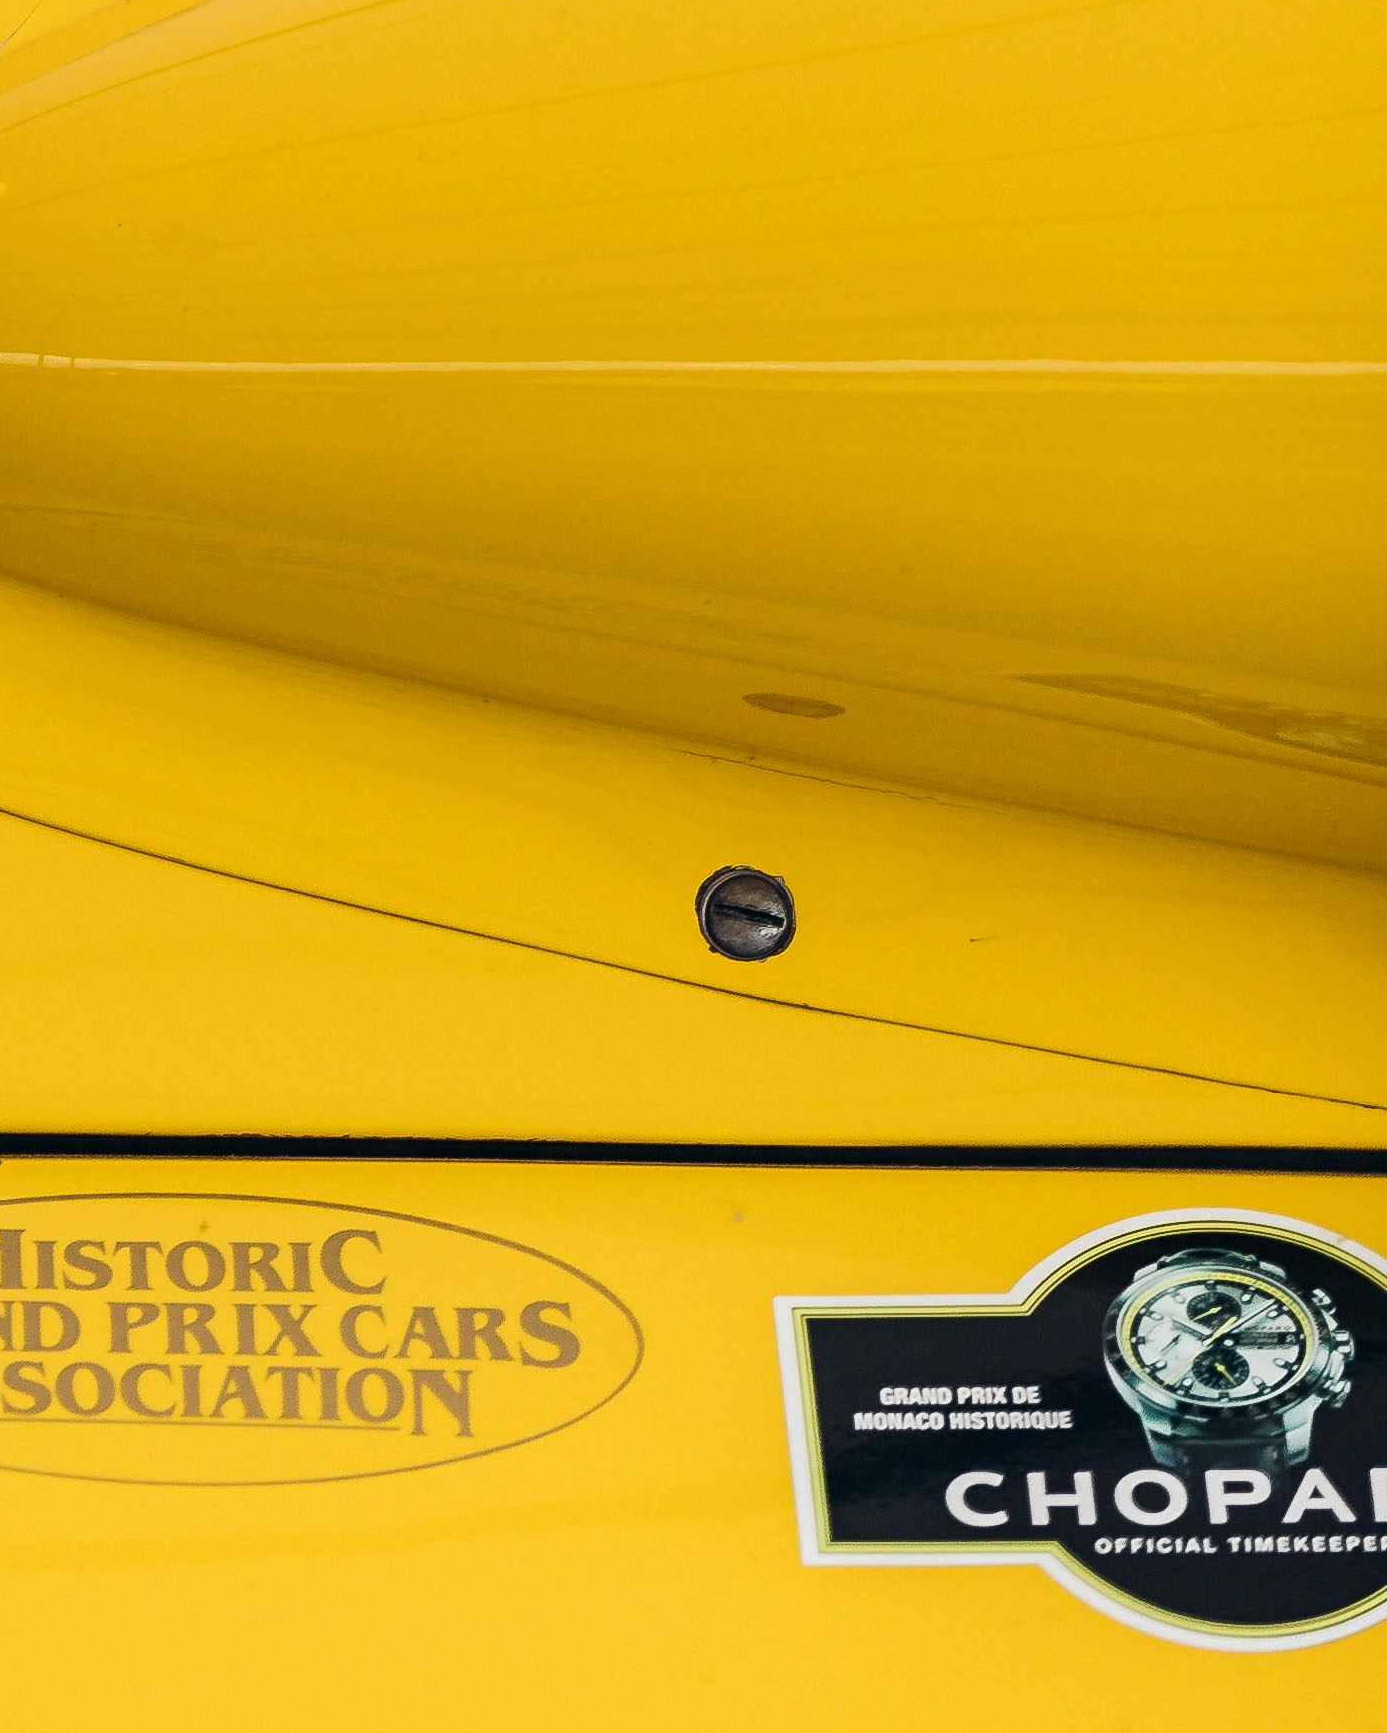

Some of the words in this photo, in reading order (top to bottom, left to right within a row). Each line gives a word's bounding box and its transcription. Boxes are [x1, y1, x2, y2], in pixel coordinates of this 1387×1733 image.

[107, 1299, 325, 1358] PRIX
[338, 1298, 582, 1370] CARS
[880, 1386, 952, 1406] GRAND
[957, 1386, 1009, 1406] PRIX
[1011, 1385, 1041, 1404] DE
[854, 1412, 944, 1431] MONACO
[949, 1410, 1074, 1431] HISTORIQUE
[1094, 1536, 1219, 1555] OFFICIAL
